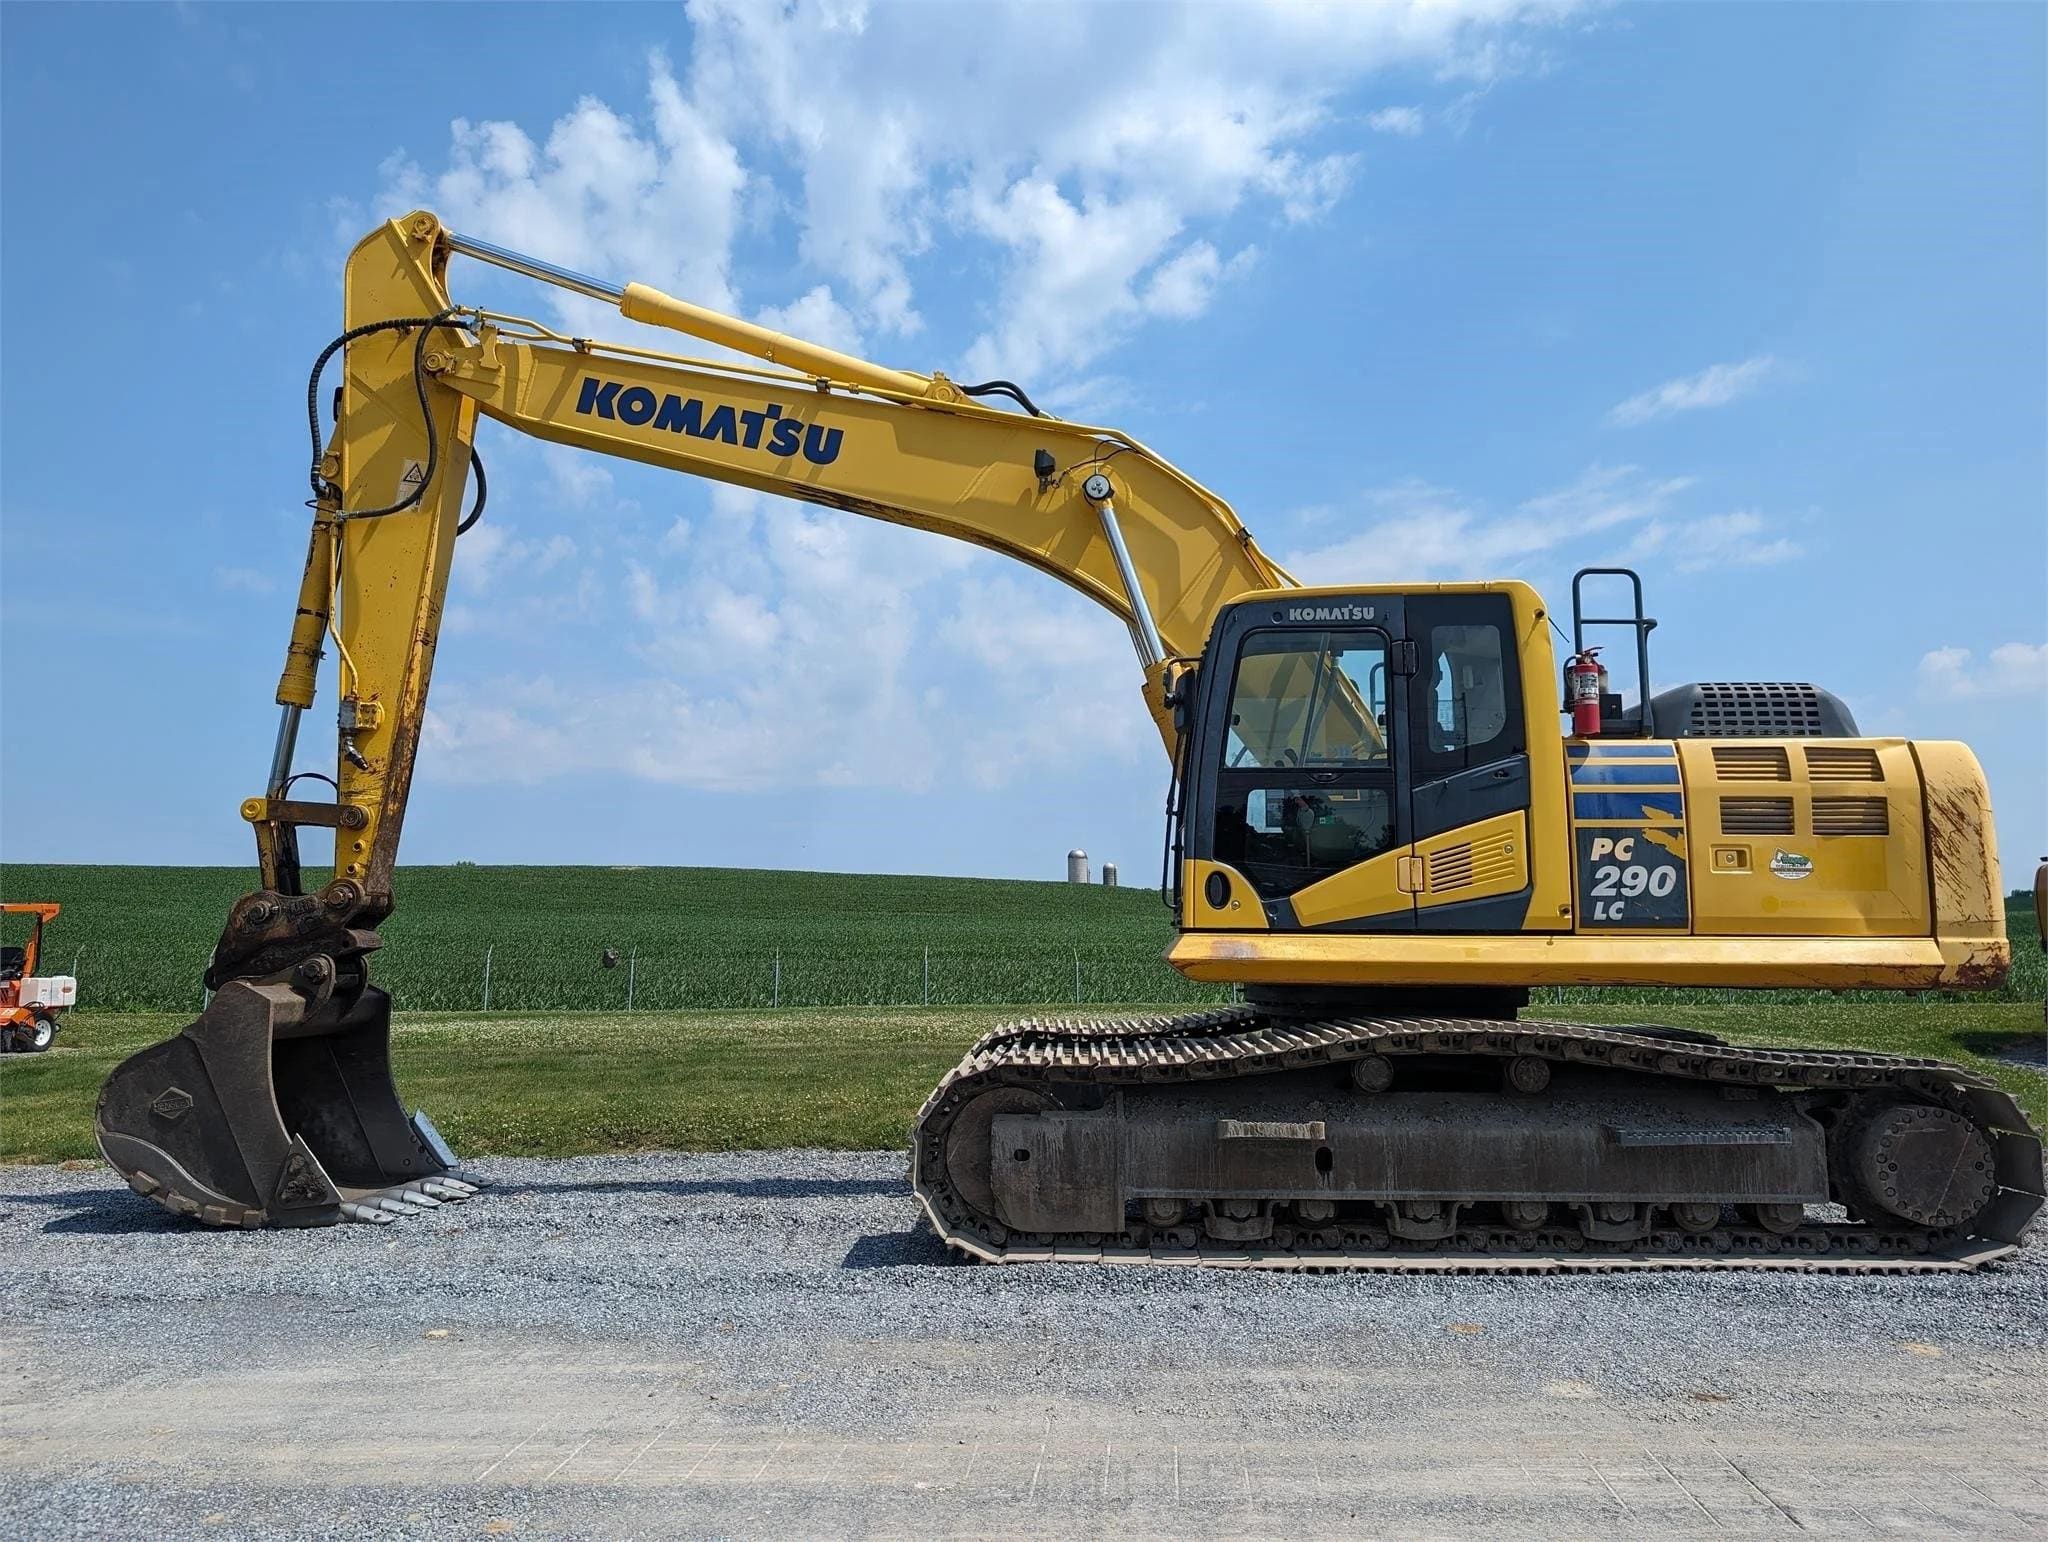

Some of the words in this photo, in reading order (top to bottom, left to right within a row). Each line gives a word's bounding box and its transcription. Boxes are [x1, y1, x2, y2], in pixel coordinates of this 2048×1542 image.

[576, 377, 844, 465] KOMATSU
[1289, 604, 1375, 620] KOMATSU
[1590, 837, 1635, 862] PC
[1590, 865, 1677, 897] 290
[1593, 901, 1625, 920] LC
